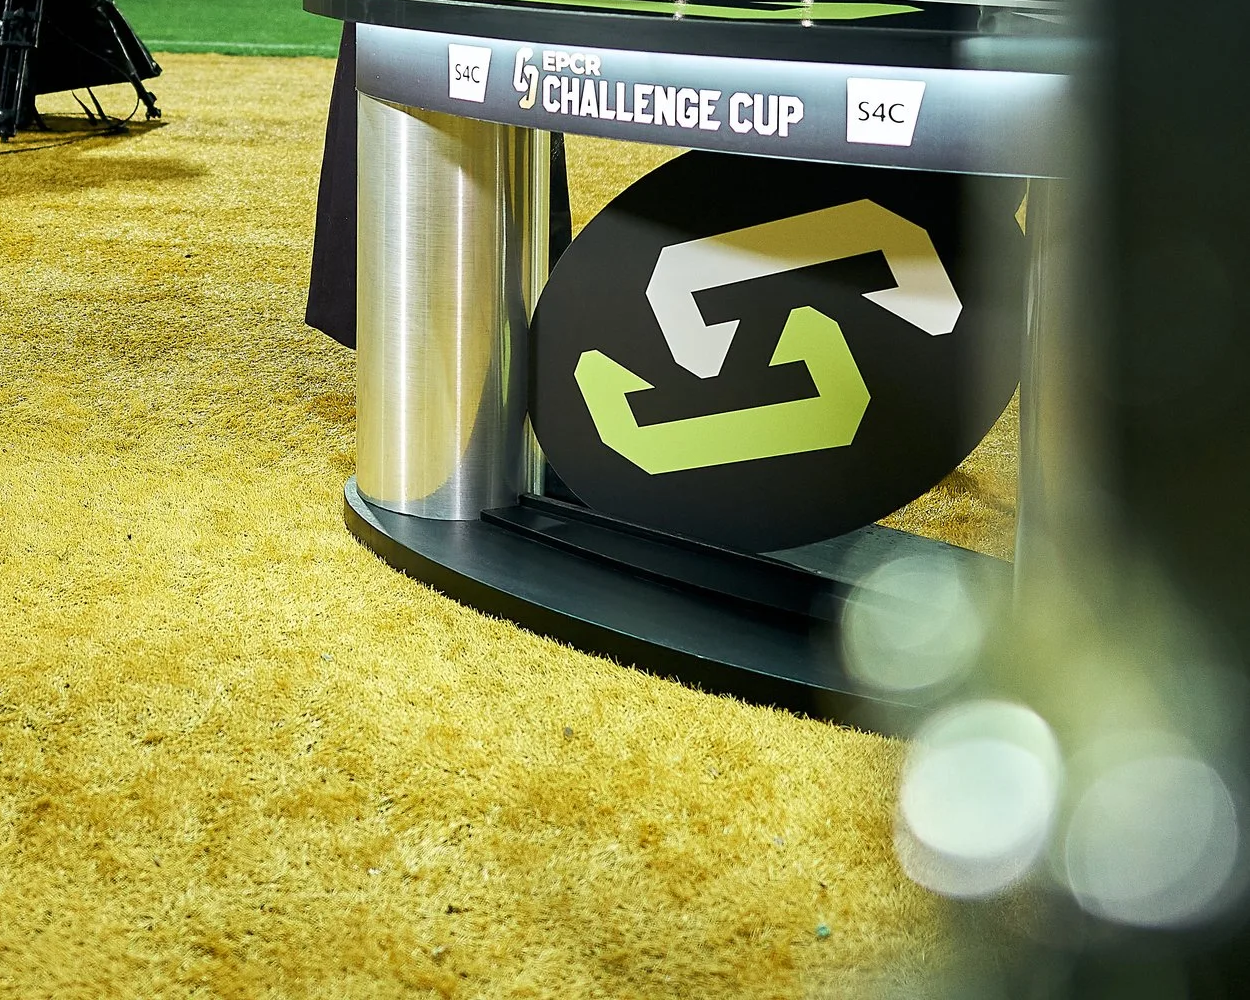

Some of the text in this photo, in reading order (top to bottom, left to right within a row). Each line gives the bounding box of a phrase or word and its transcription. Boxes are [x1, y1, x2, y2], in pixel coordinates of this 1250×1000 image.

[455, 63, 480, 84] S4C
[542, 50, 601, 76] EPCR
[542, 74, 804, 138] CHALLENGE CUP
[857, 101, 905, 124] S4C
